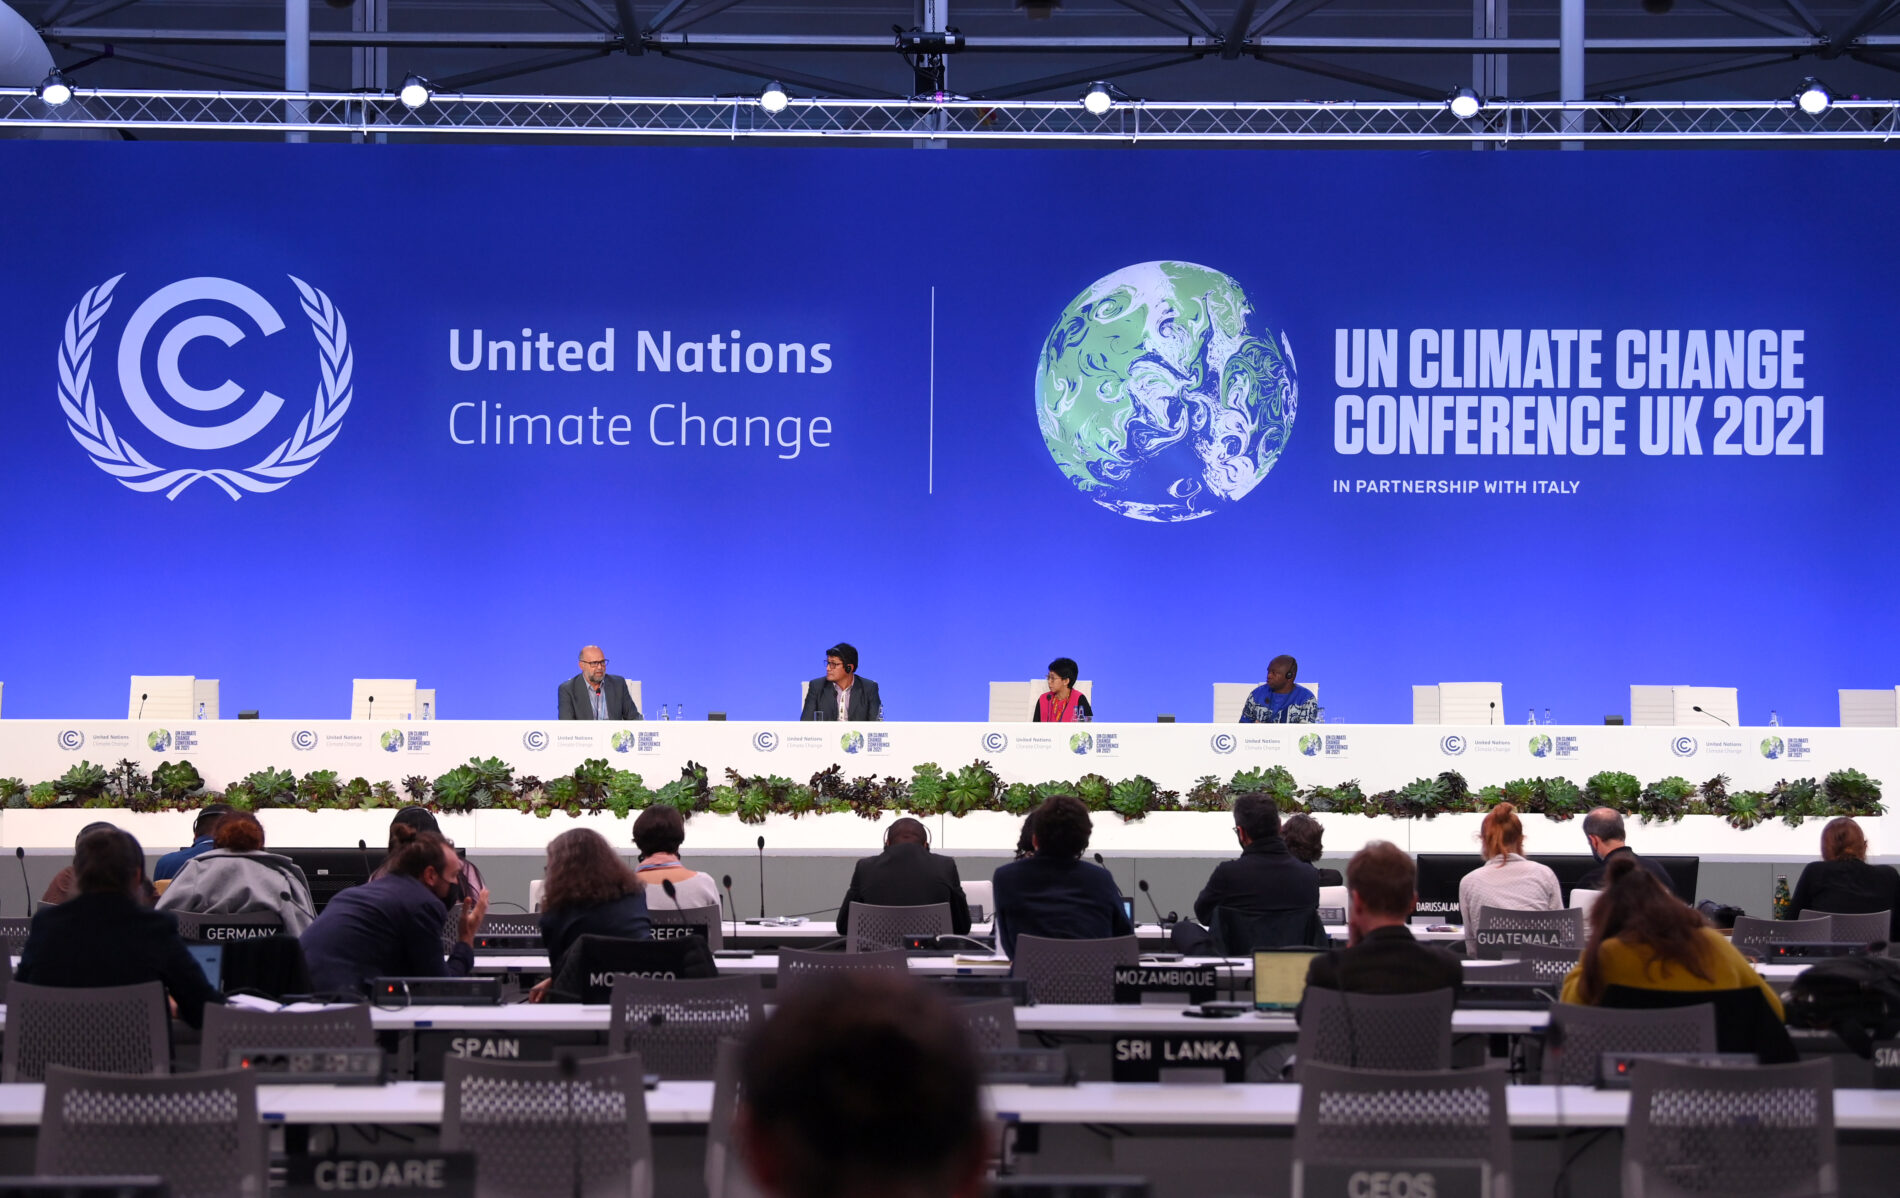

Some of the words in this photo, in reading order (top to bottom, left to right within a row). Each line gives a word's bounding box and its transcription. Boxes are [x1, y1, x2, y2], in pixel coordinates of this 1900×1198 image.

[450, 328, 614, 371] United
[638, 330, 832, 373] Nations
[1335, 329, 1397, 388] UN
[1410, 329, 1602, 388] CLIMATE
[1616, 330, 1804, 389] CHANGE
[450, 401, 631, 445] Climate
[650, 402, 831, 459] Change
[1334, 395, 1625, 455] CONFERENCE
[1640, 396, 1703, 455] UK
[1714, 396, 1823, 455] 2021
[1333, 479, 1350, 493] IN
[1356, 479, 1479, 494] PARTNERSHIP
[1484, 480, 1527, 494] WITH
[1532, 480, 1580, 494] ITALY
[1416, 902, 1459, 912] DARUSSALAM
[206, 927, 277, 940] GERMANY
[649, 928, 694, 940] REECE
[1477, 932, 1559, 945] GUATEMALA
[1115, 970, 1215, 987] MOZAMBIQUE
[451, 1038, 519, 1058] SPAIN
[1116, 1039, 1152, 1060] SRI
[1163, 1040, 1241, 1061] LANKA
[314, 1159, 446, 1191] CEDARE
[1347, 1170, 1437, 1198] CEOS
